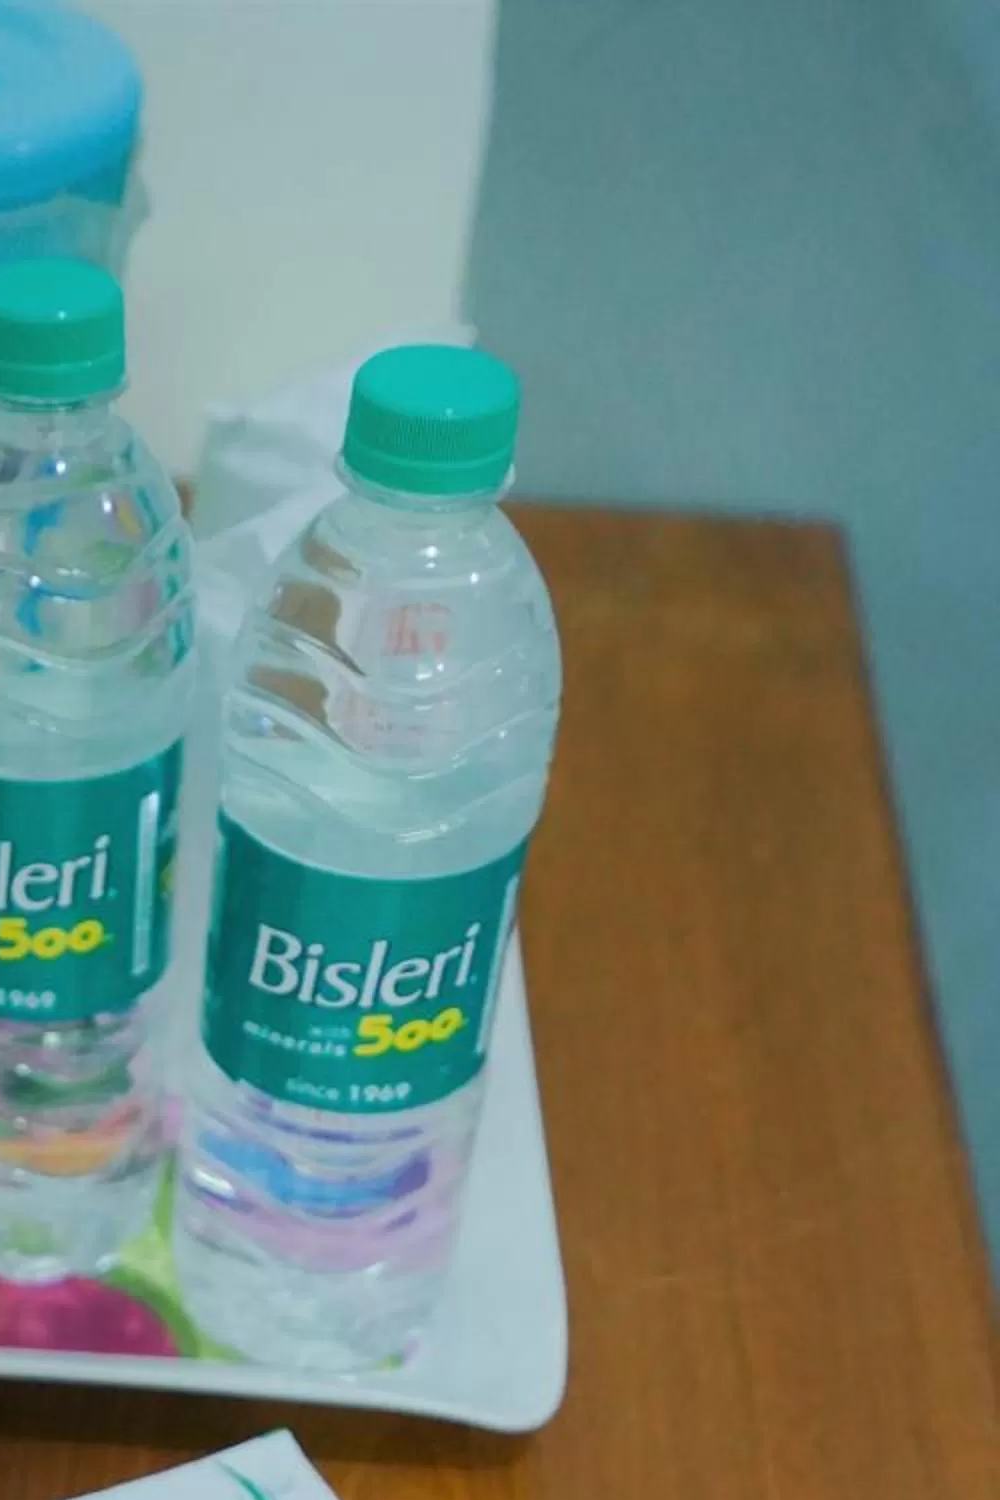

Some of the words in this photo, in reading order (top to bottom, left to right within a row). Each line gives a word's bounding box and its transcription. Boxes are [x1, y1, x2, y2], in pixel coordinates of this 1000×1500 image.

[249, 922, 481, 1009] Bisleri
[242, 1020, 347, 1057] minerals
[353, 1006, 465, 1057] 500
[349, 1082, 412, 1102] 1969
